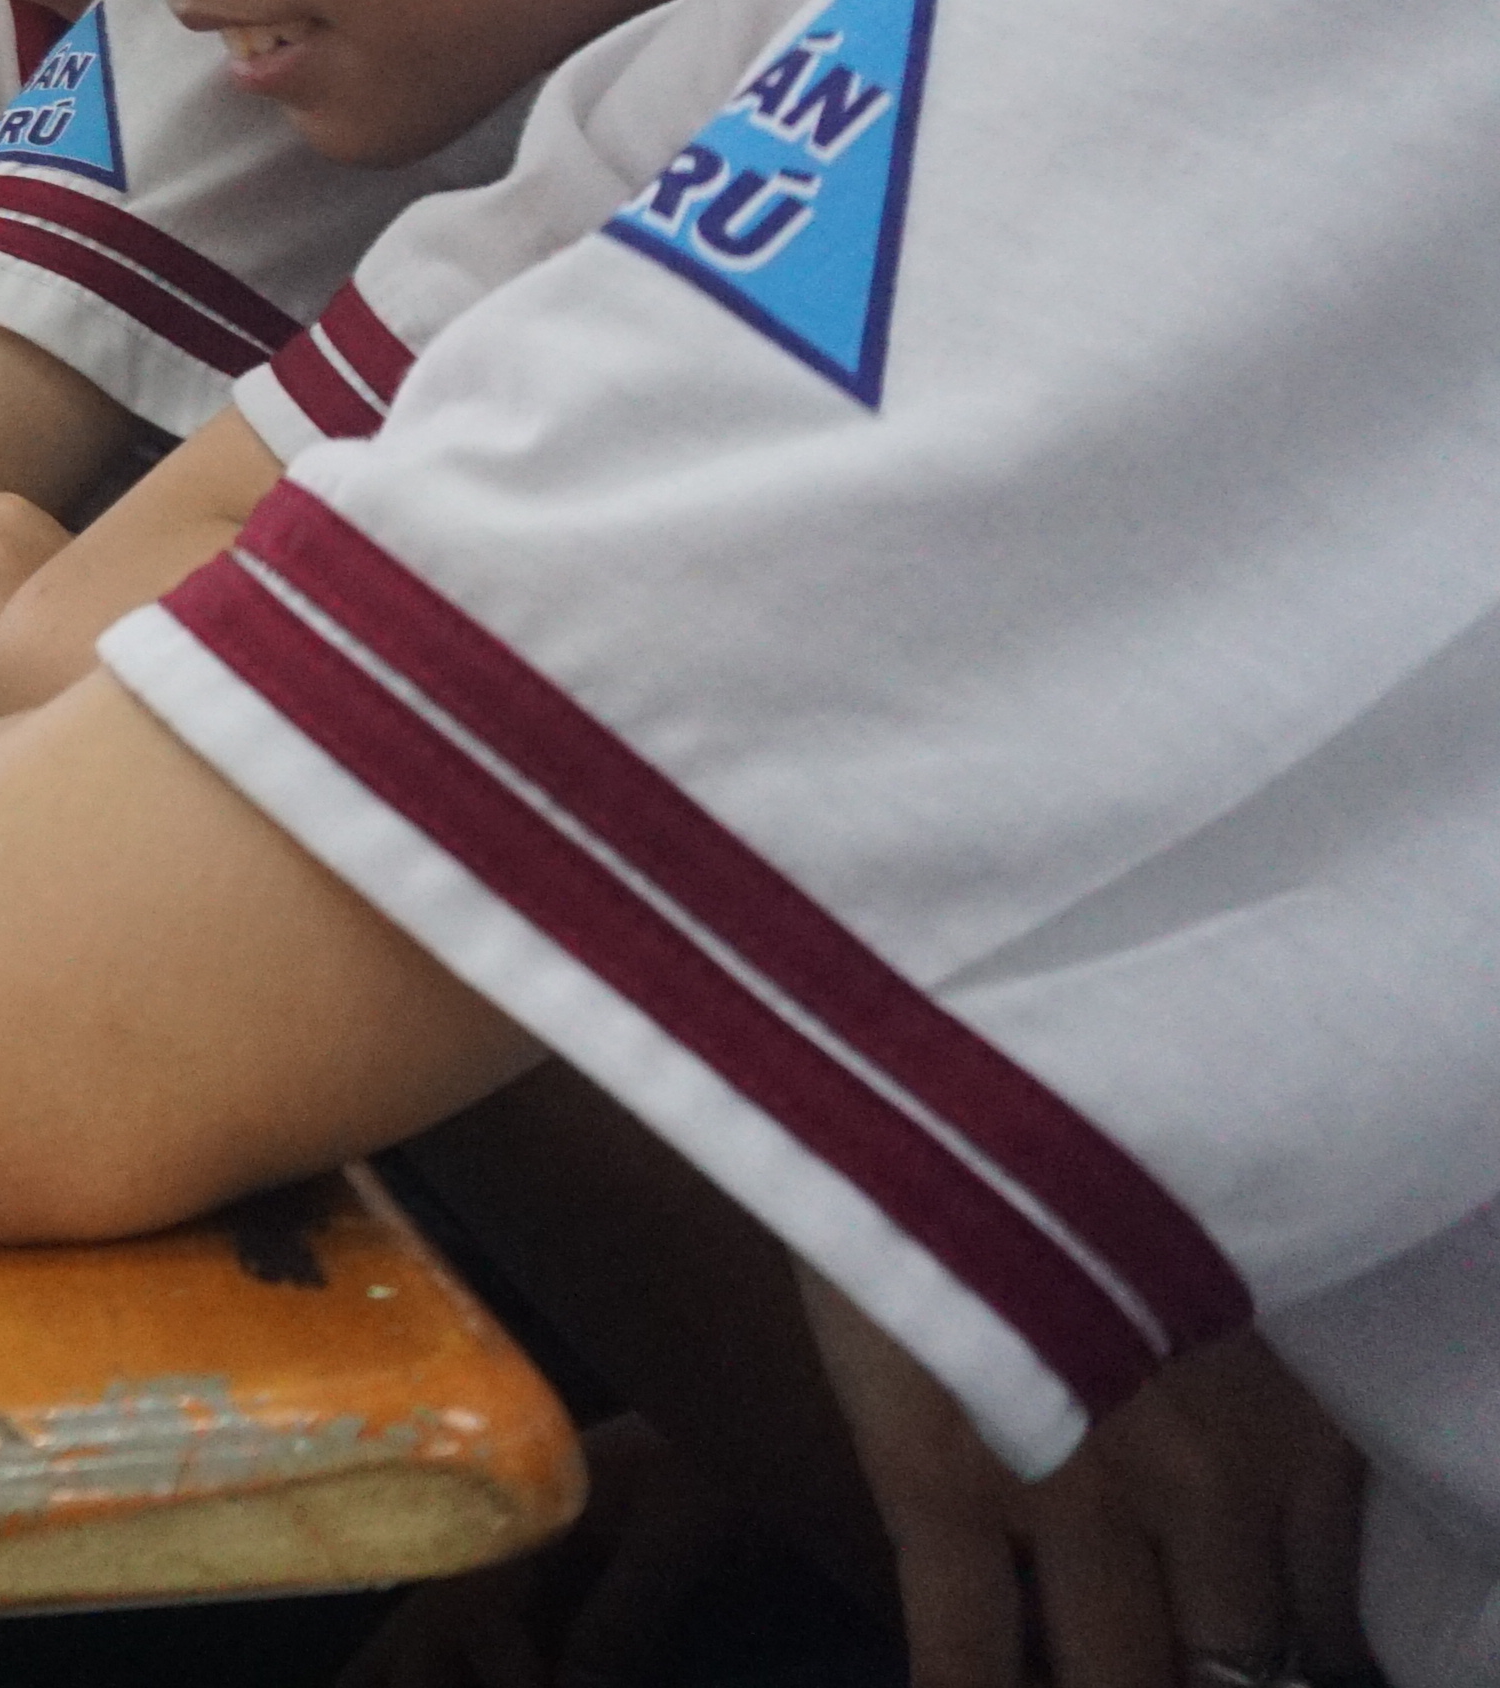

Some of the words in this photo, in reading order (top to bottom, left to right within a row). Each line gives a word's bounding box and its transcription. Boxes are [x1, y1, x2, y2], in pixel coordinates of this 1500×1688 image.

[28, 42, 97, 90] ÁN
[735, 30, 889, 157] ÁN
[643, 141, 820, 267] RÚ
